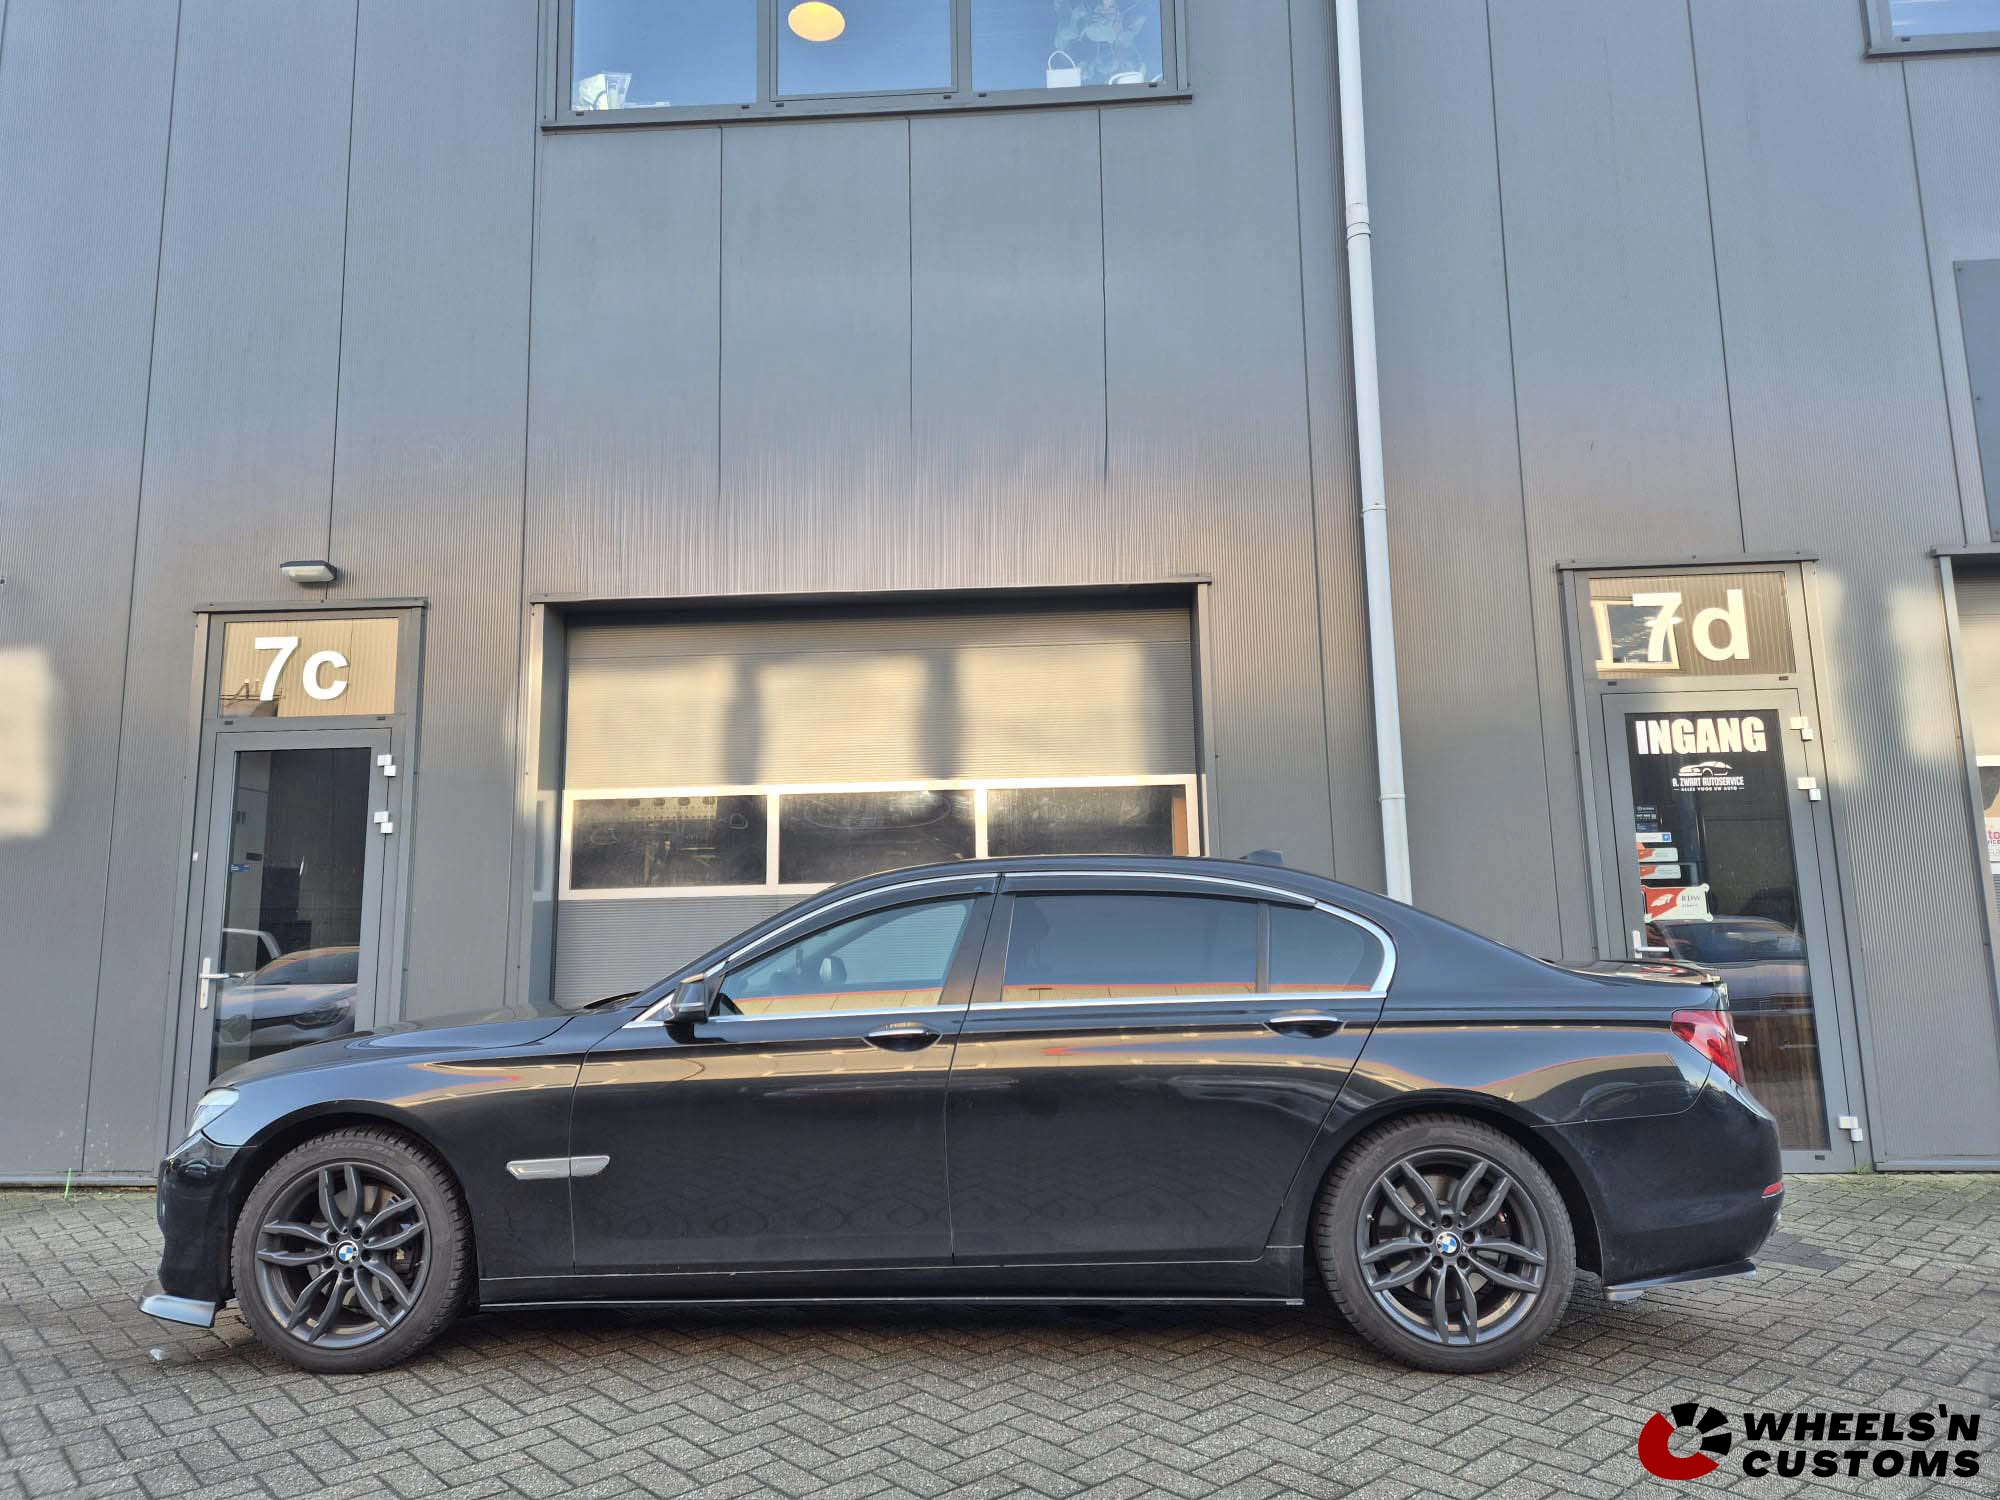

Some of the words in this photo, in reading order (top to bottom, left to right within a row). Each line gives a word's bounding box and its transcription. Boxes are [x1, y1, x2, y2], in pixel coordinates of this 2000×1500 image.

[1632, 589, 1749, 661] 7d
[255, 636, 349, 701] 7c
[1635, 716, 1767, 755] INGANG
[1680, 777, 1701, 787] ZWART
[1702, 776, 1744, 786] AUTOSERVICE
